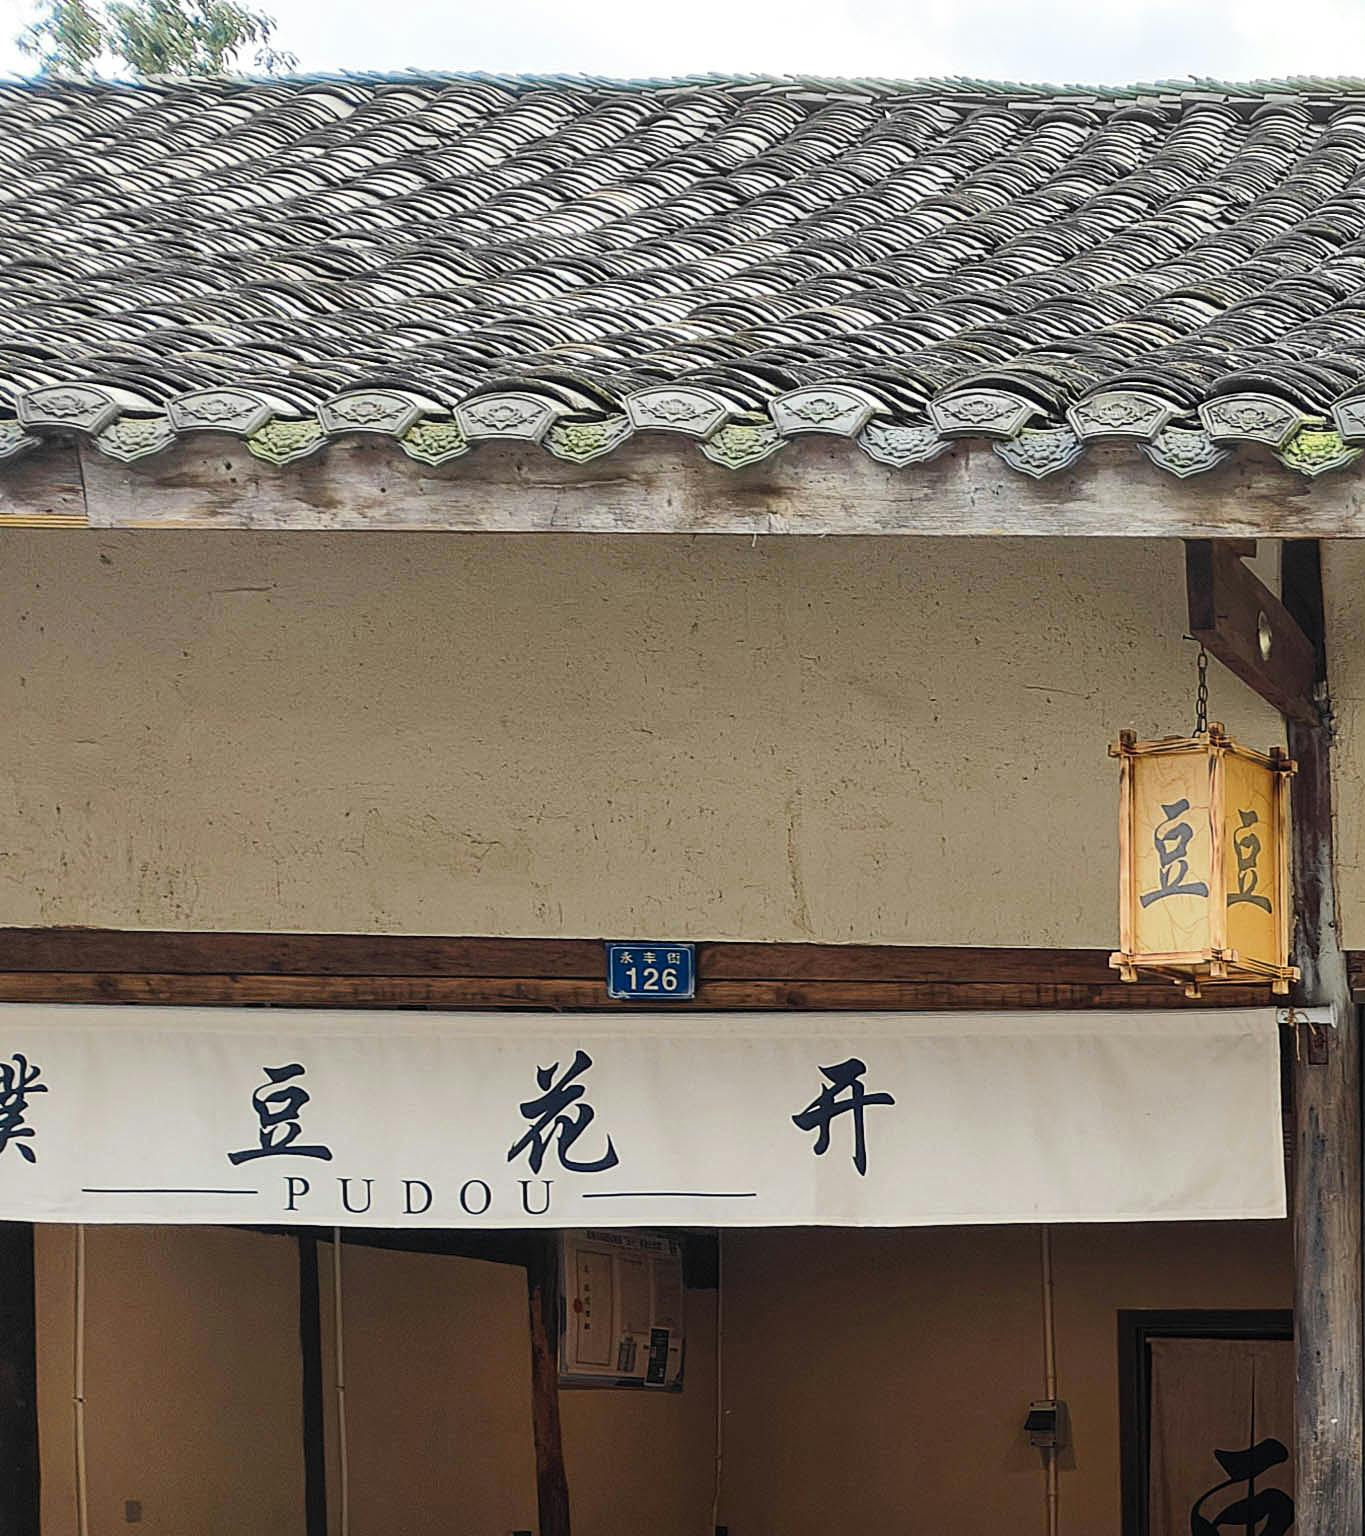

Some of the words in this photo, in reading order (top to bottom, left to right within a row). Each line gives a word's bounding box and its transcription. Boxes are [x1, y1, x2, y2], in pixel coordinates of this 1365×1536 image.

[1140, 799, 1210, 909] 豆
[1226, 809, 1273, 914] 豆
[626, 967, 678, 991] 126
[284, 1176, 556, 1216] PUDOU
